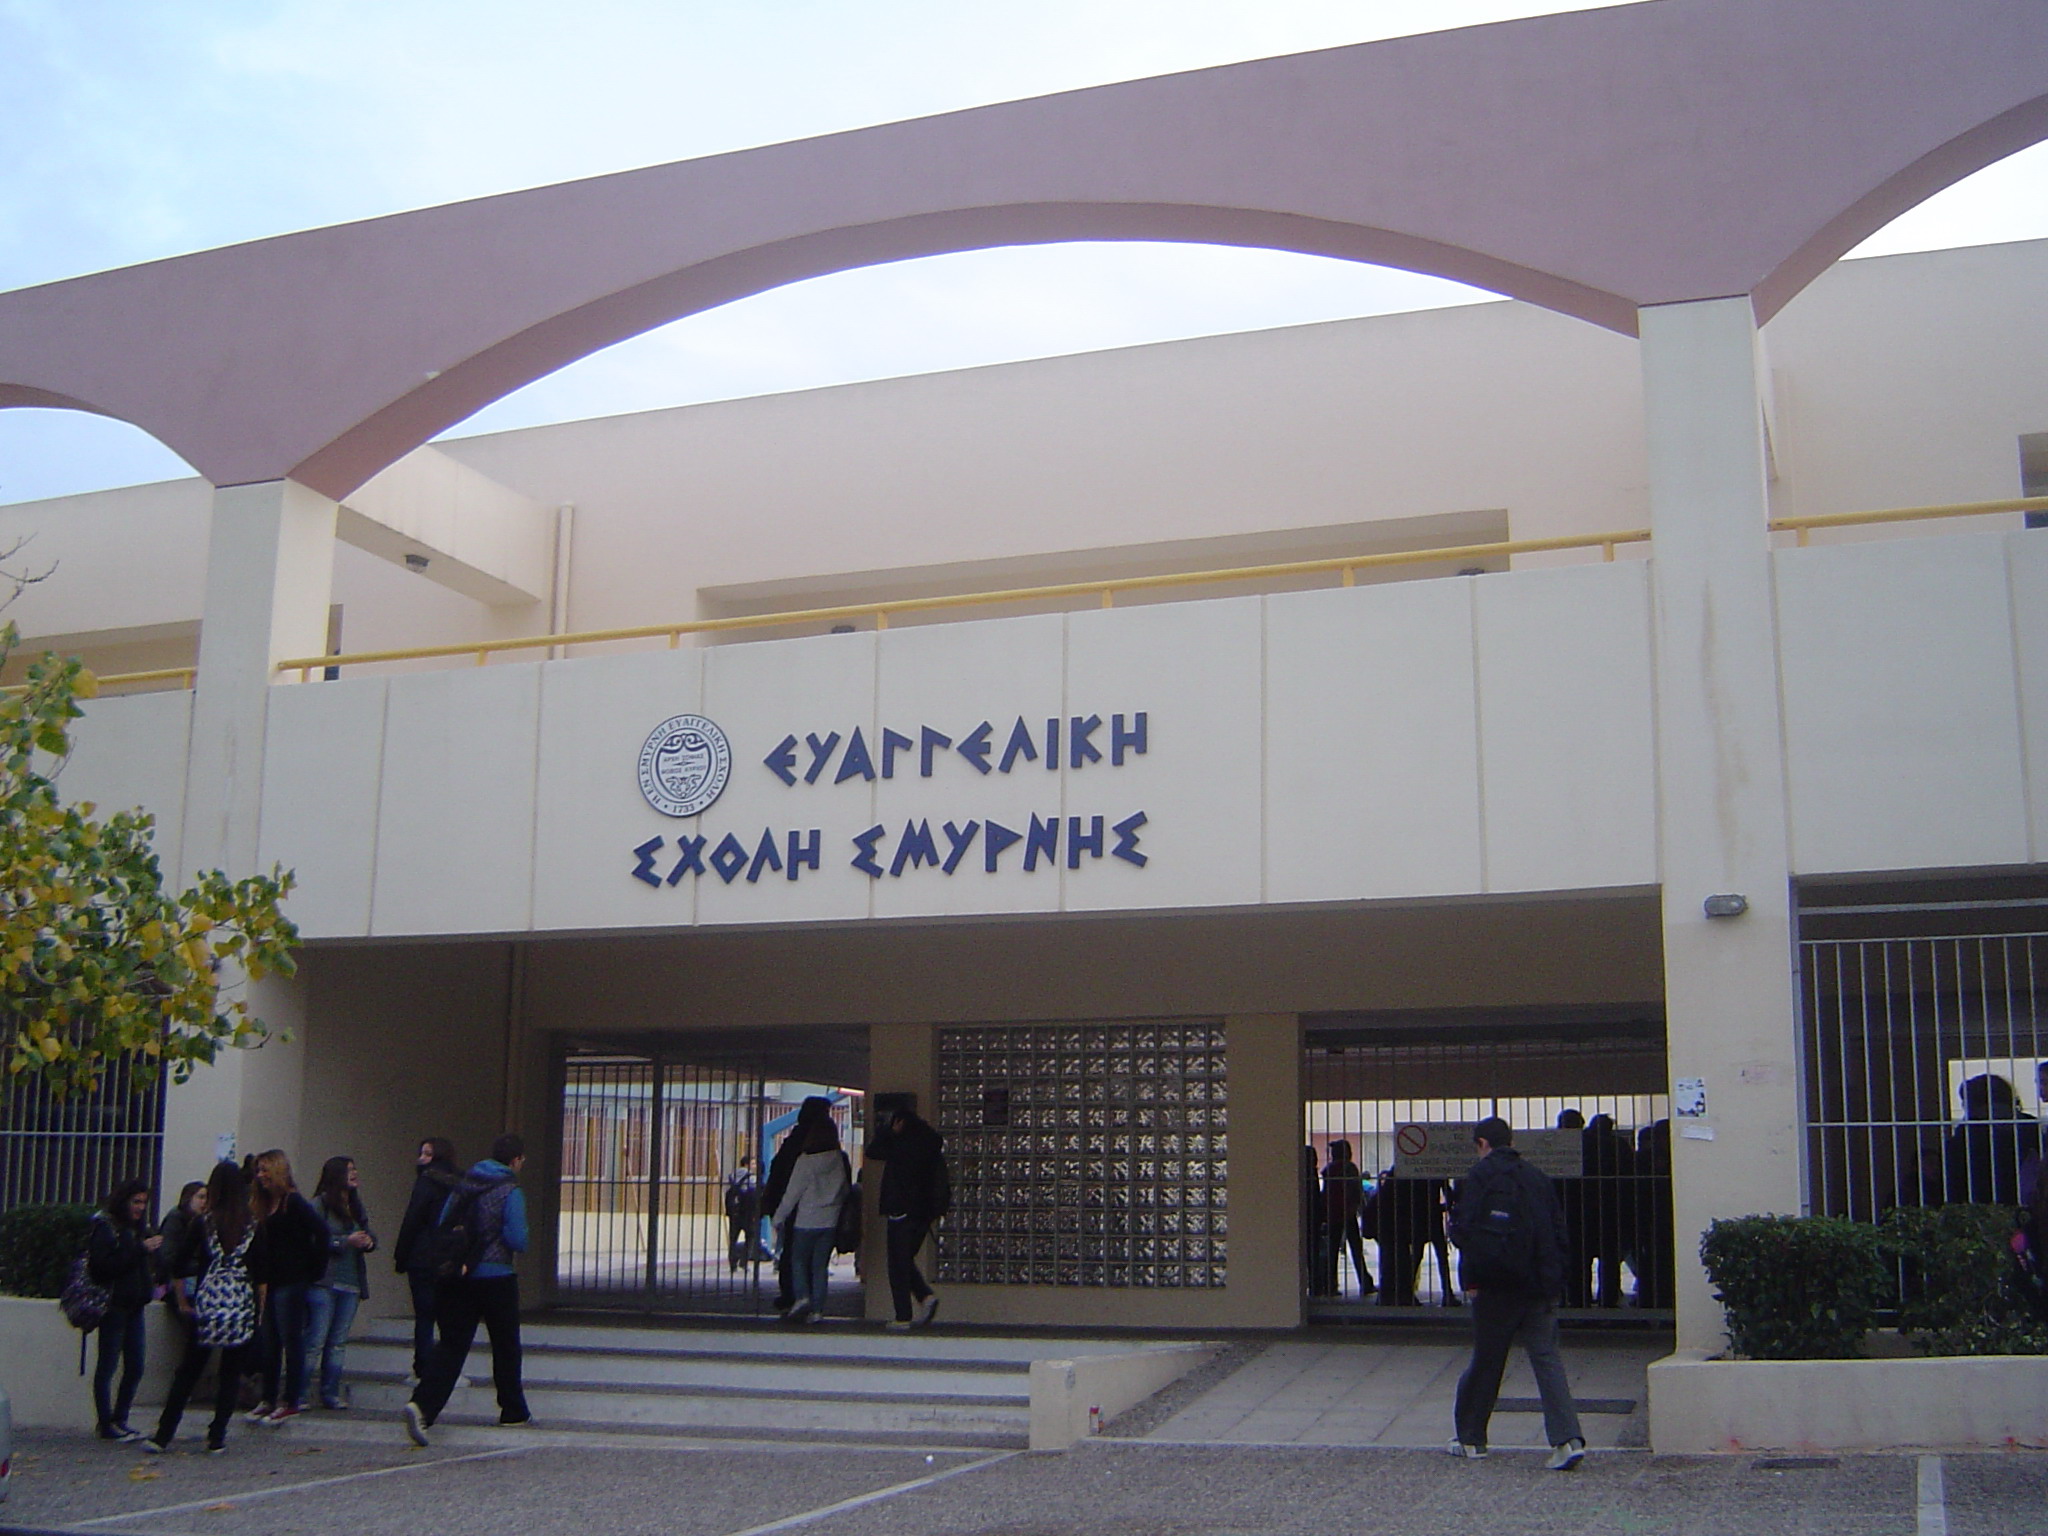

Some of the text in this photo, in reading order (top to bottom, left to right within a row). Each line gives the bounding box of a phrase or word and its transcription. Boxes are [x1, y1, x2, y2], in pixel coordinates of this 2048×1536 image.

[641, 728, 666, 775] ΣΜΥΡΝΗ
[669, 718, 726, 752] ΕΥΑΓΓΕΛΙΚΗ
[706, 757, 727, 799] ΣΧΟΛΗ
[763, 712, 1147, 786] ΕΥΑΓΓΕΛΙΚΗ
[673, 804, 694, 813] 1733
[631, 811, 1148, 888] ΣΧΟΛΗ ΣΜΥΡΝΗΣ
